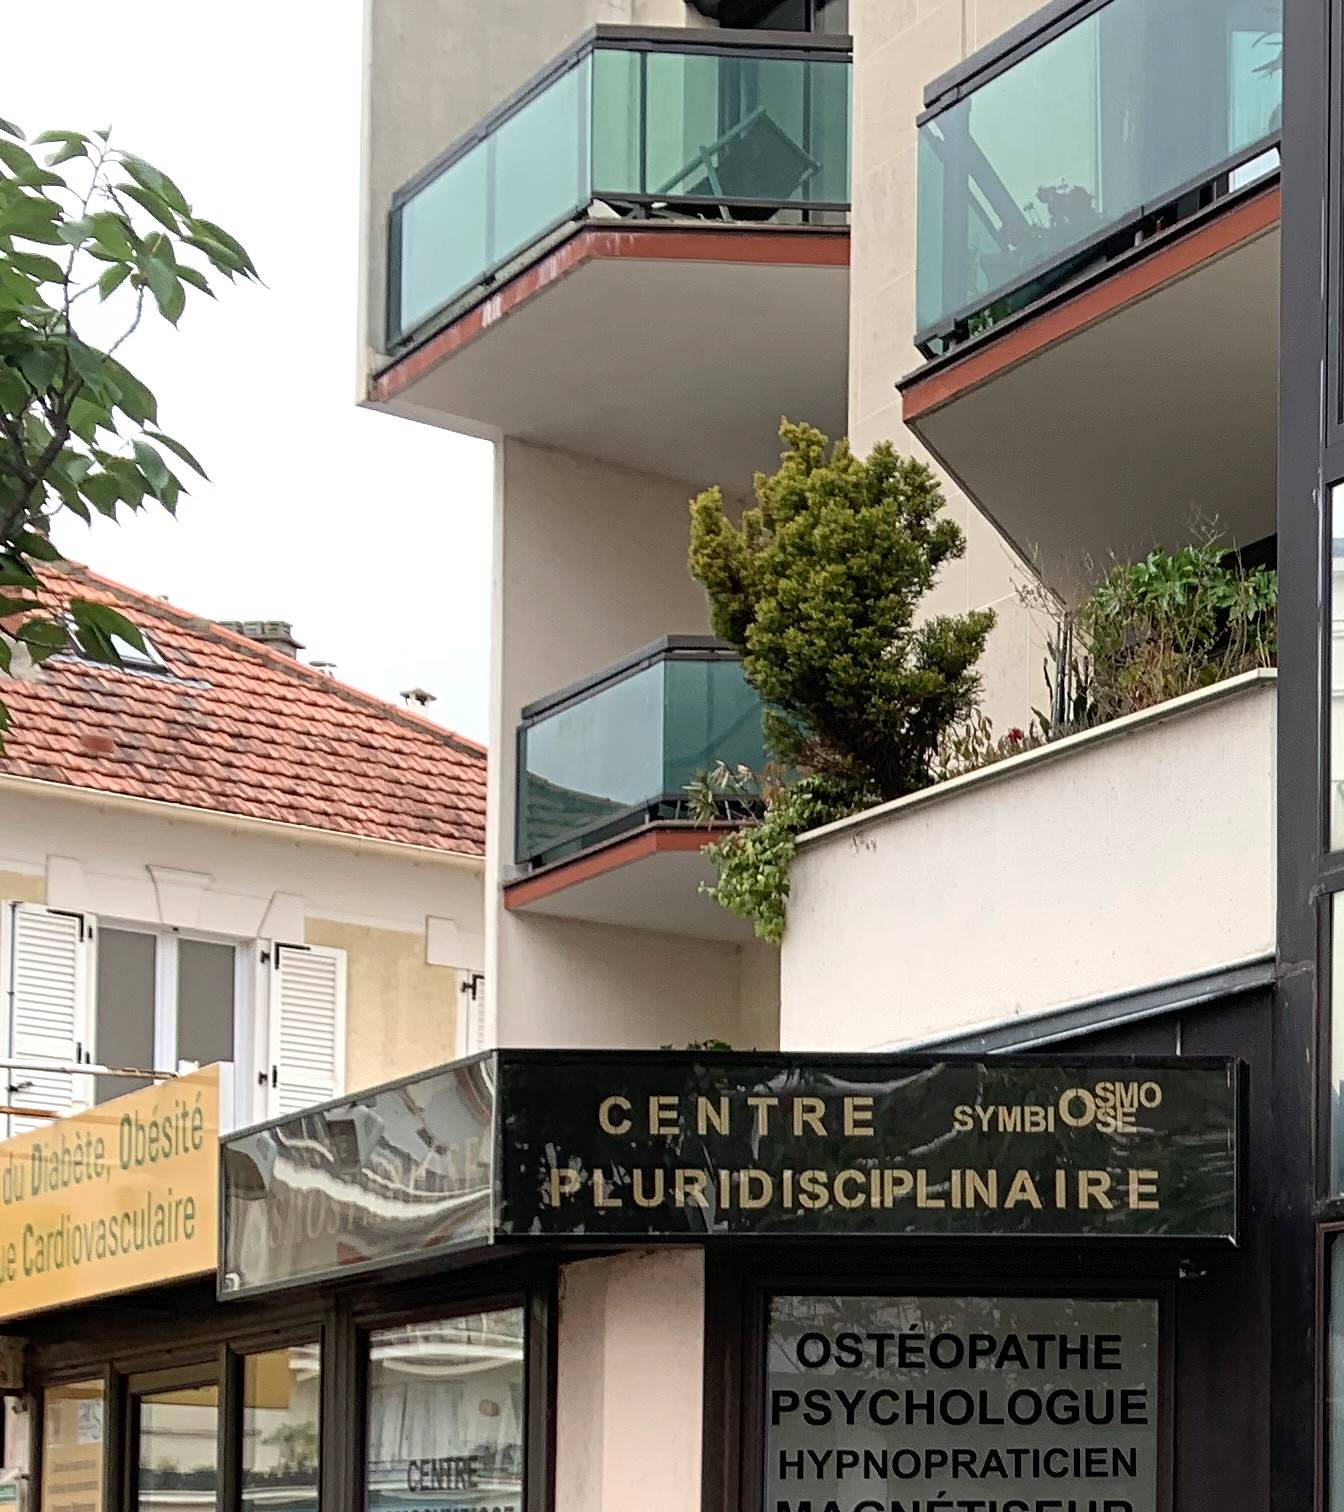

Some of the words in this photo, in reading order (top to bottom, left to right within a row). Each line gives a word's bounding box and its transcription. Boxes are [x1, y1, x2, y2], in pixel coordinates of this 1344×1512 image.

[118, 1090, 204, 1171] Obésité
[600, 1096, 875, 1138] CENTRE
[550, 1168, 1161, 1210] PLURIDISCIPLINAIRE
[22, 1187, 196, 1277] Cardiovasculaire
[796, 1323, 1122, 1370] OSTÉOPATHE
[771, 1389, 1149, 1426] PSYCHOLOGUE
[408, 1455, 478, 1492] CENTRE
[778, 1447, 1139, 1480] HYPNOPRATICIEN
